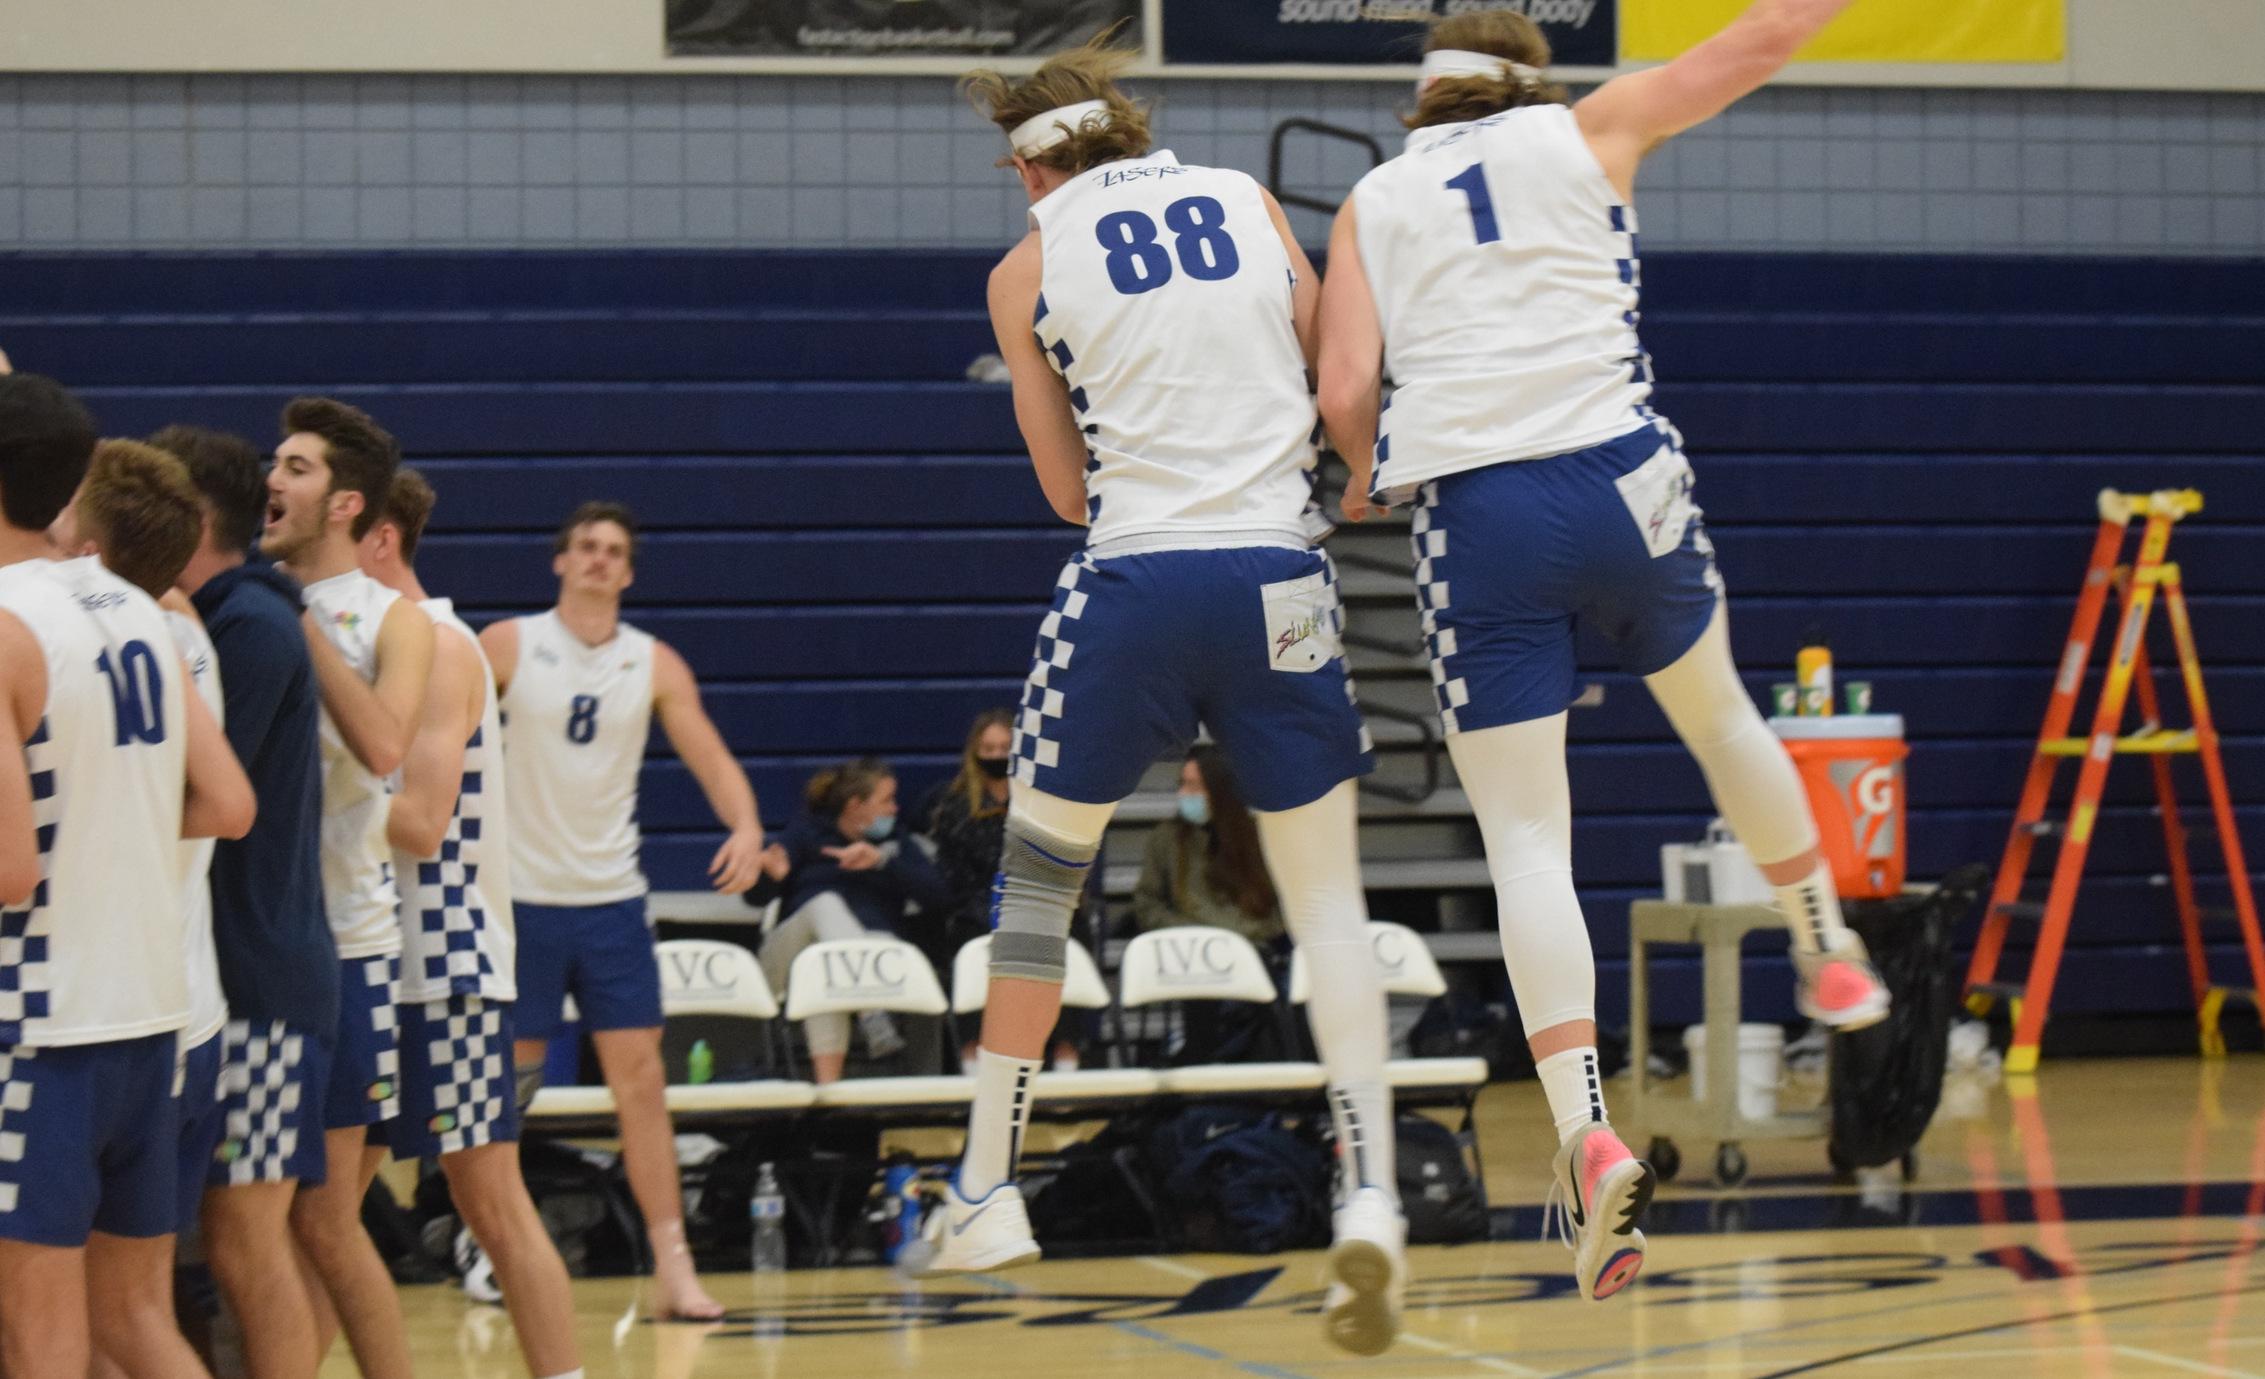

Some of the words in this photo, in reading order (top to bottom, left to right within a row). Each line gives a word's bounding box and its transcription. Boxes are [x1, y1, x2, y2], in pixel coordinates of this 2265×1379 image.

[1278, 0, 1361, 23] sound
[1528, 0, 1597, 29] body
[1443, 161, 1502, 245] 1
[1095, 195, 1240, 295] 88
[94, 639, 167, 746] 10
[566, 694, 599, 745] 8
[1857, 766, 1894, 814] G
[661, 948, 740, 990] VC
[819, 946, 908, 988] IVC
[1151, 936, 1237, 976] IVC
